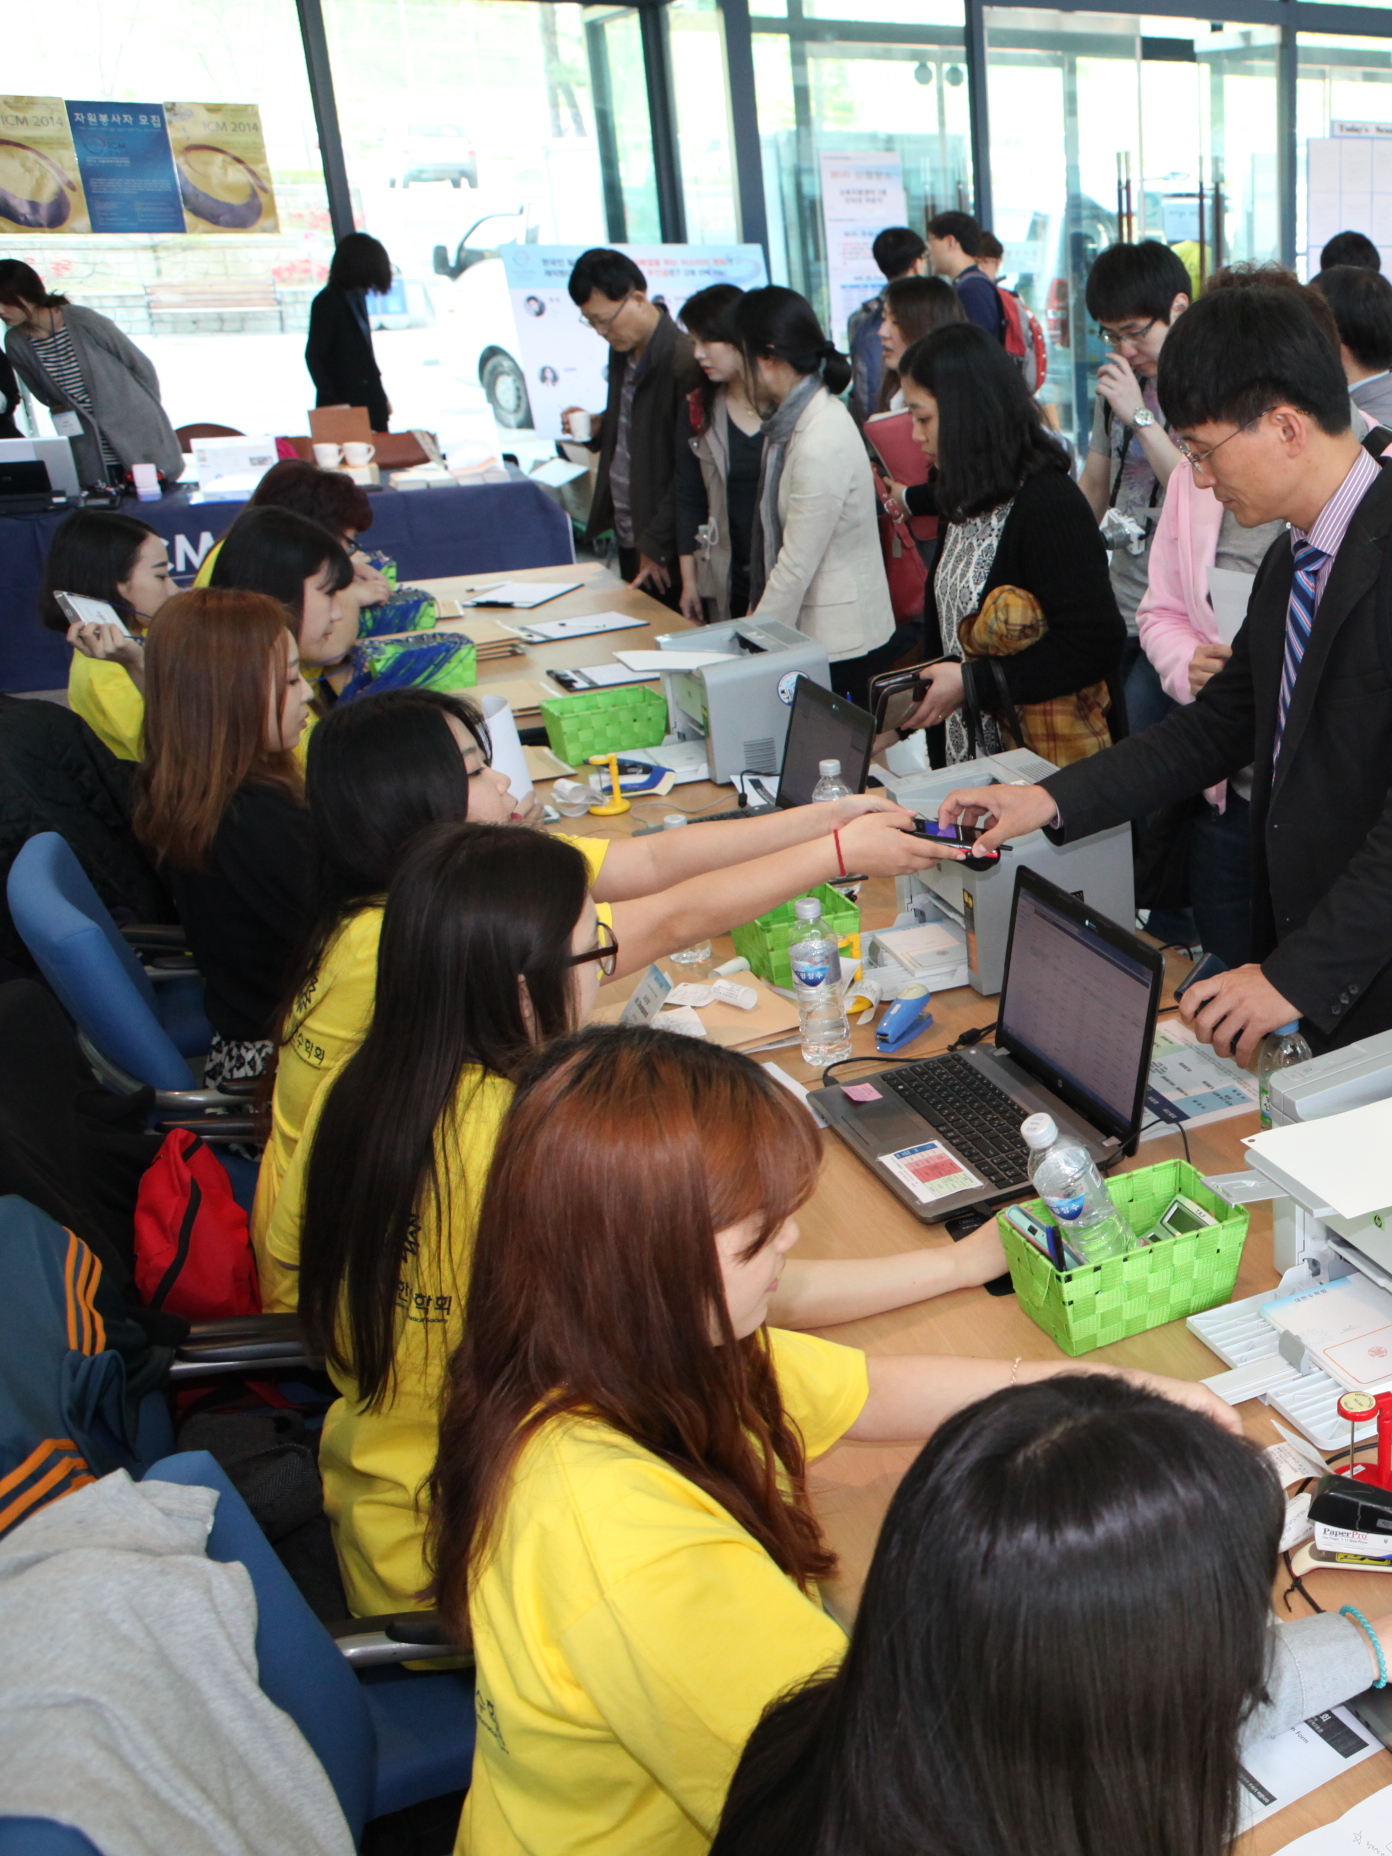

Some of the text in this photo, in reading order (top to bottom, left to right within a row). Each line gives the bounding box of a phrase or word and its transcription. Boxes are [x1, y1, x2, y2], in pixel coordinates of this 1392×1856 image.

[1, 114, 64, 128] ICM 2014
[73, 113, 162, 129] 자원봉사자 모집
[203, 121, 259, 133] ICM 2014
[1339, 124, 1369, 135] Today's
[1323, 1527, 1368, 1540] PaperPro
[1295, 1730, 1309, 1744] Form
